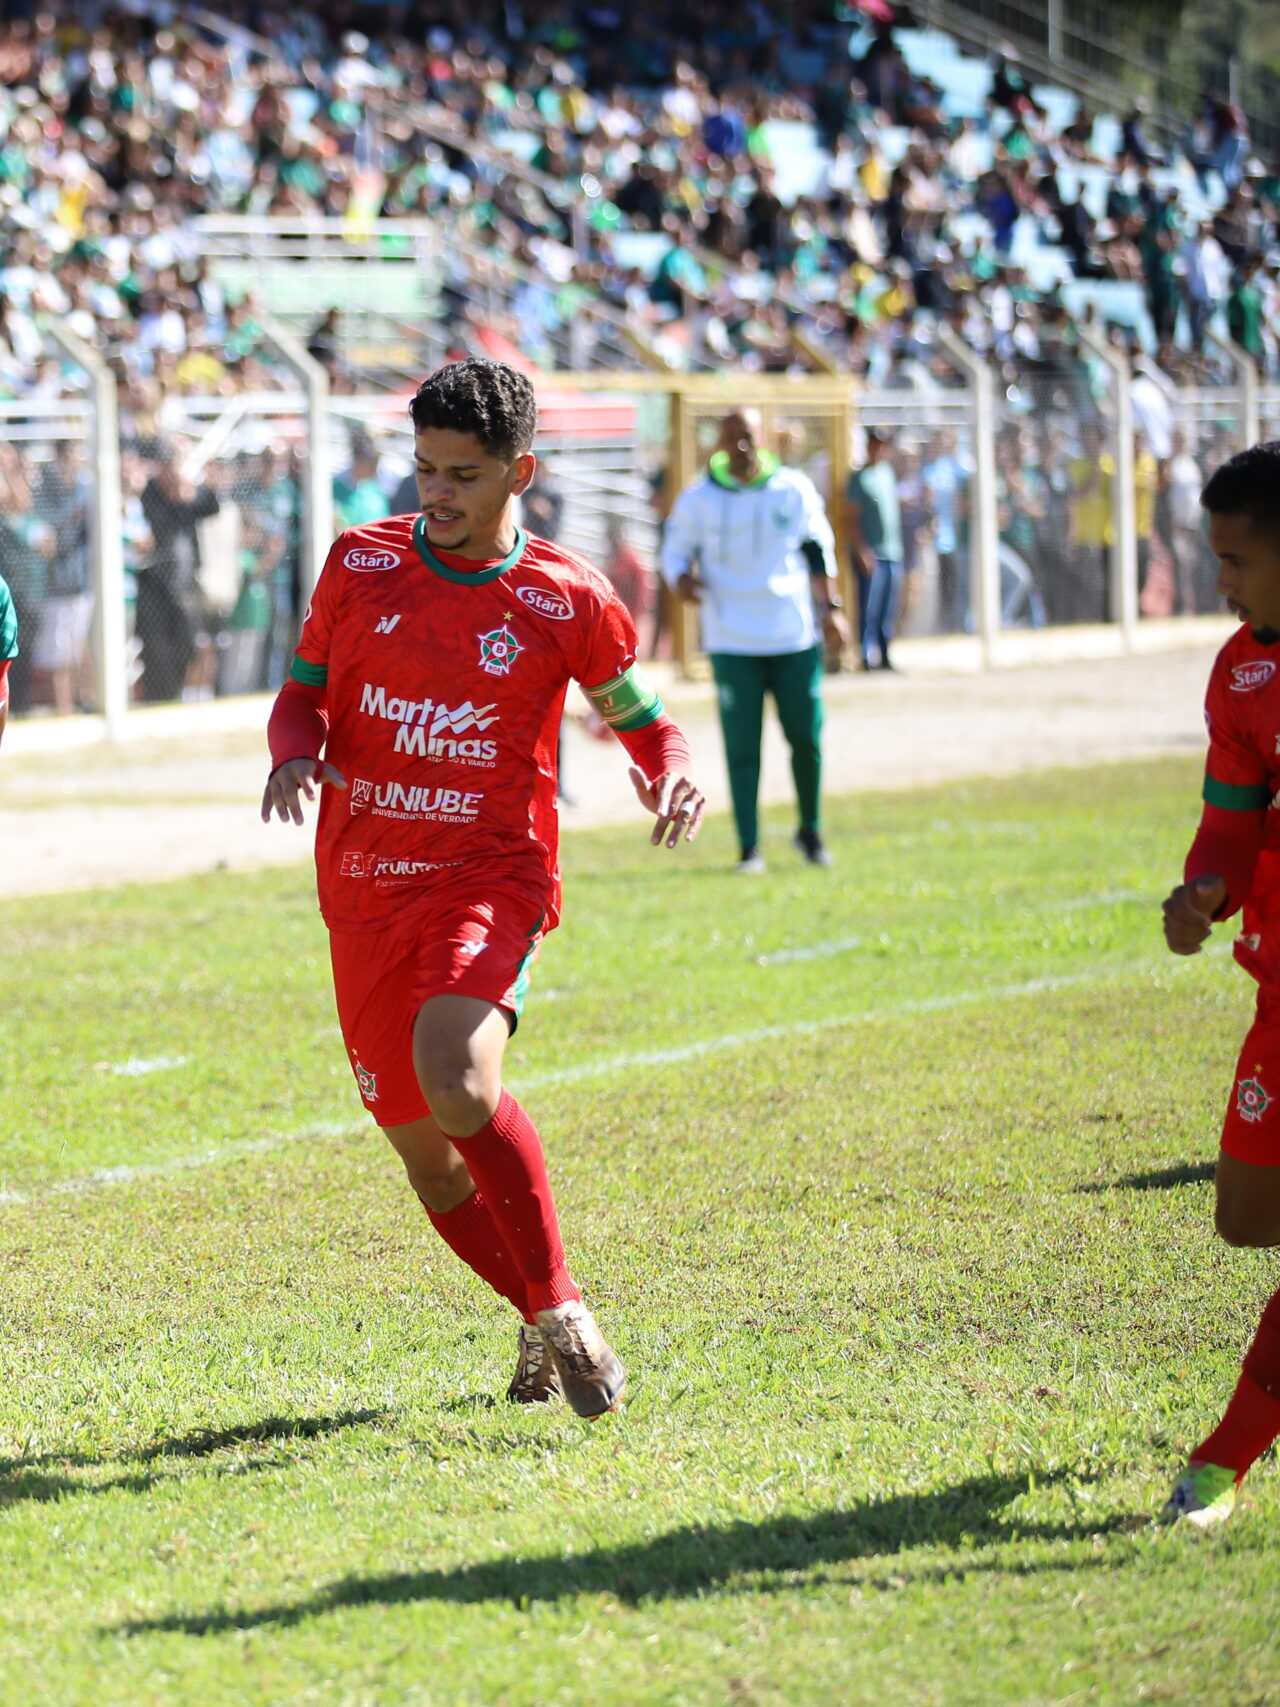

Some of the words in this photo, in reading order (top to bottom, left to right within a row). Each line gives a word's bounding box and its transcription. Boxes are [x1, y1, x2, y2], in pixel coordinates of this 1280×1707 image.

[351, 552, 390, 568] Start
[525, 591, 566, 616] Start
[1234, 666, 1270, 687] Start
[359, 682, 435, 725] Mart
[393, 724, 497, 760] Minas
[467, 758, 496, 768] VAREJO
[374, 781, 484, 815] UNIUBE
[425, 812, 437, 821] DE
